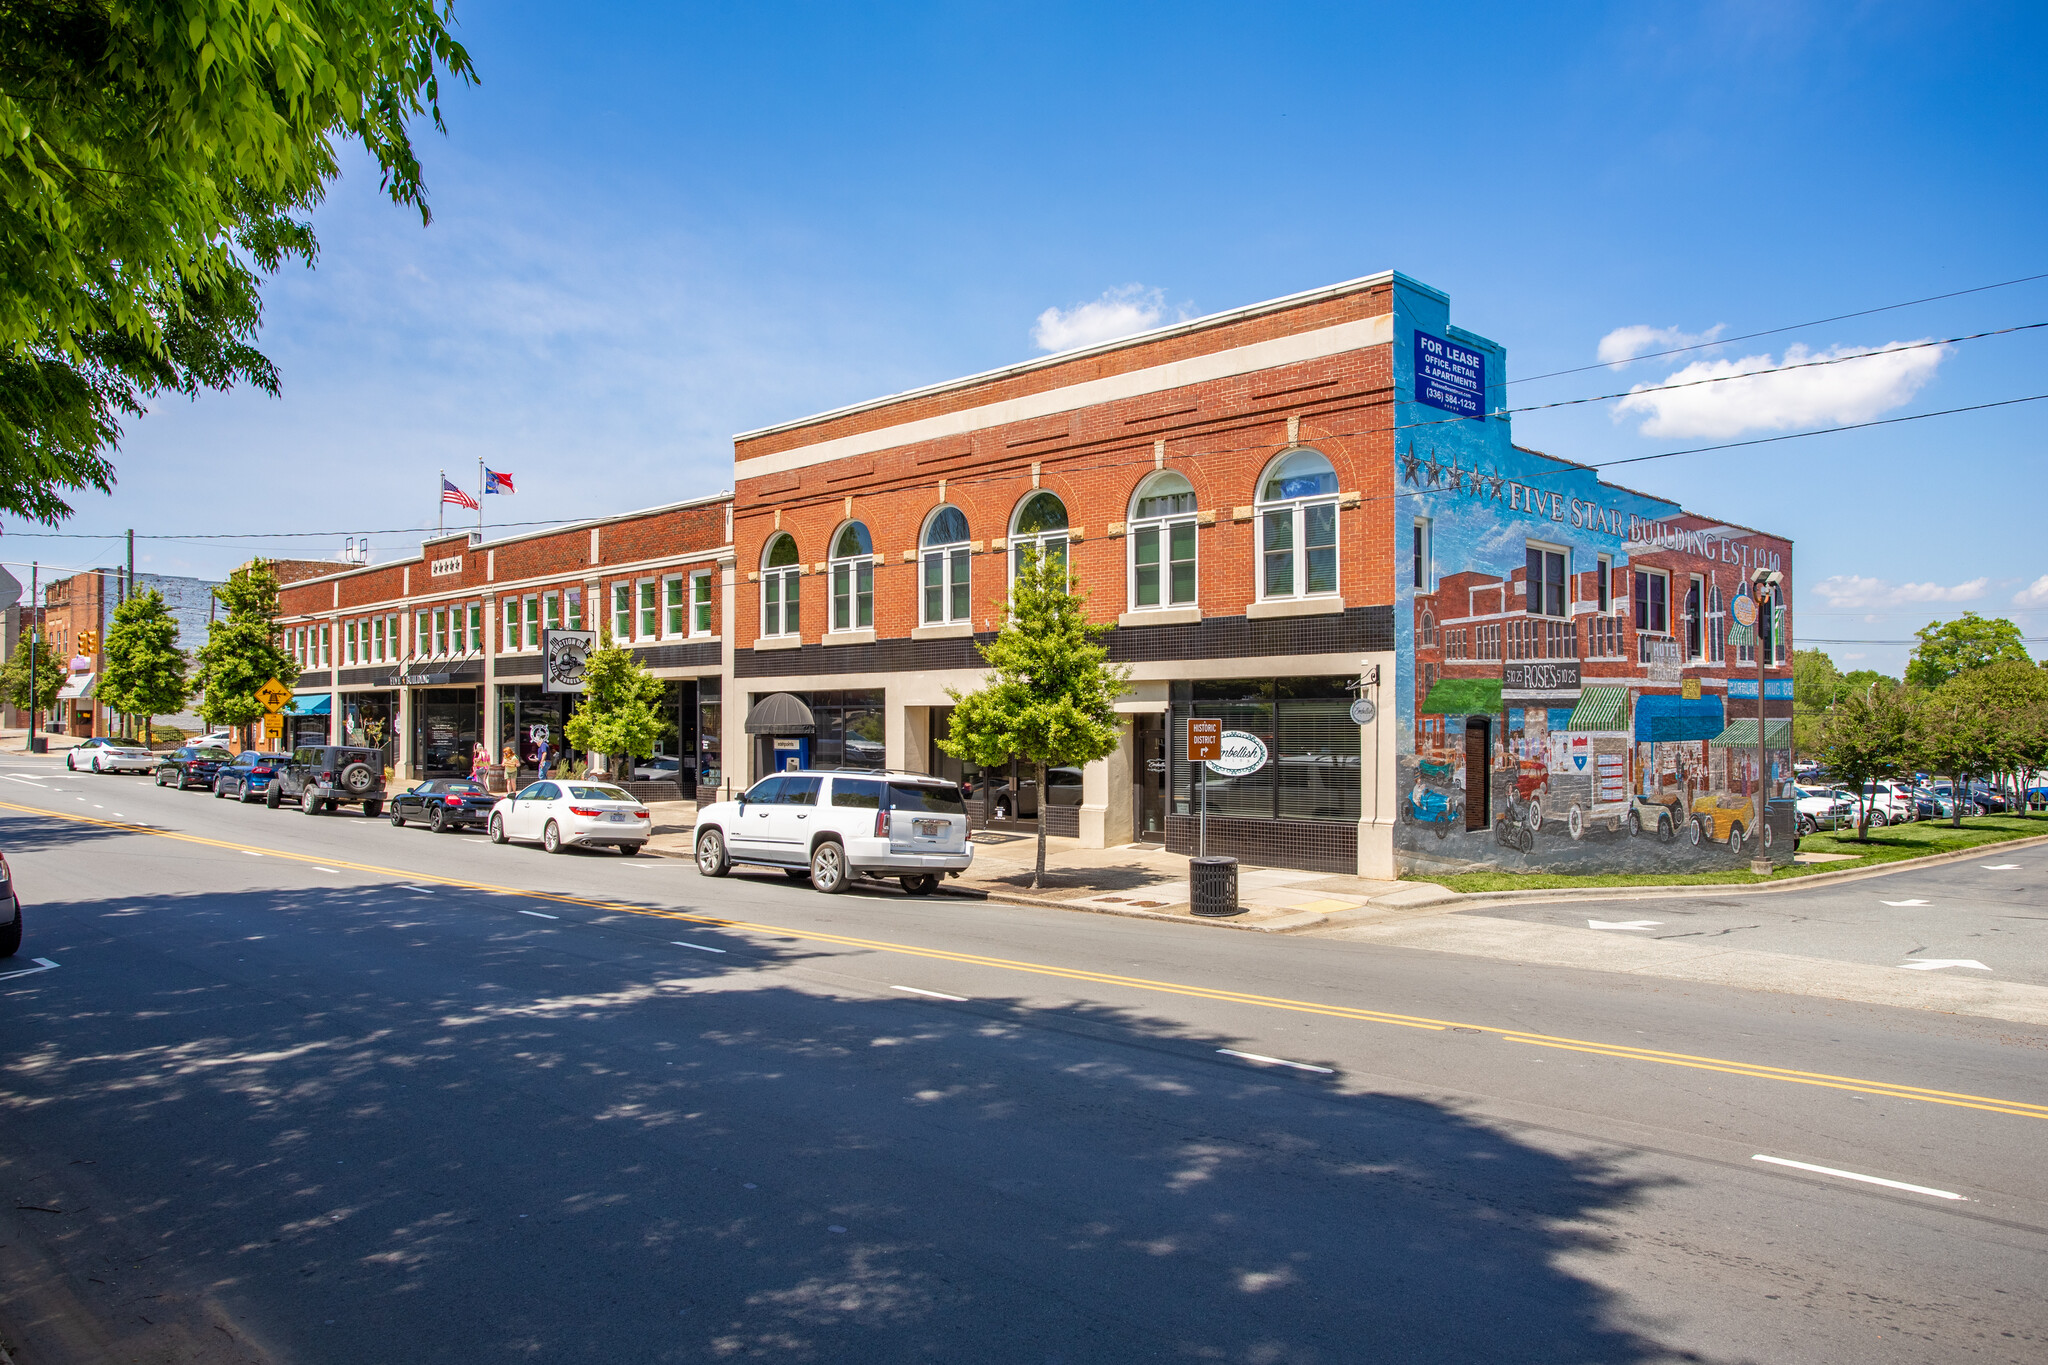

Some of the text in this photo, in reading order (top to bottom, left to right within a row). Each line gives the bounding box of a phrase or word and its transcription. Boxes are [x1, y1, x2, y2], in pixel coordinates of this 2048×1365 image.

[1421, 337, 1480, 368] FOR LEASE
[1425, 354, 1476, 378] OFFICE, RETAIL
[1425, 366, 1476, 390] & APARTMENTS
[1426, 387, 1476, 410] (336) 584-1232
[1509, 481, 1564, 522] FIVE
[1571, 498, 1625, 538] STAR
[1629, 513, 1716, 560] BUILDING
[552, 639, 576, 656] JUNCTION
[576, 640, 585, 648] ON
[1653, 642, 1681, 657] HOTEL
[1524, 664, 1556, 688] ROSE'S
[1193, 724, 1216, 732] HISTORIC
[1194, 736, 1216, 744] DISTRICT
